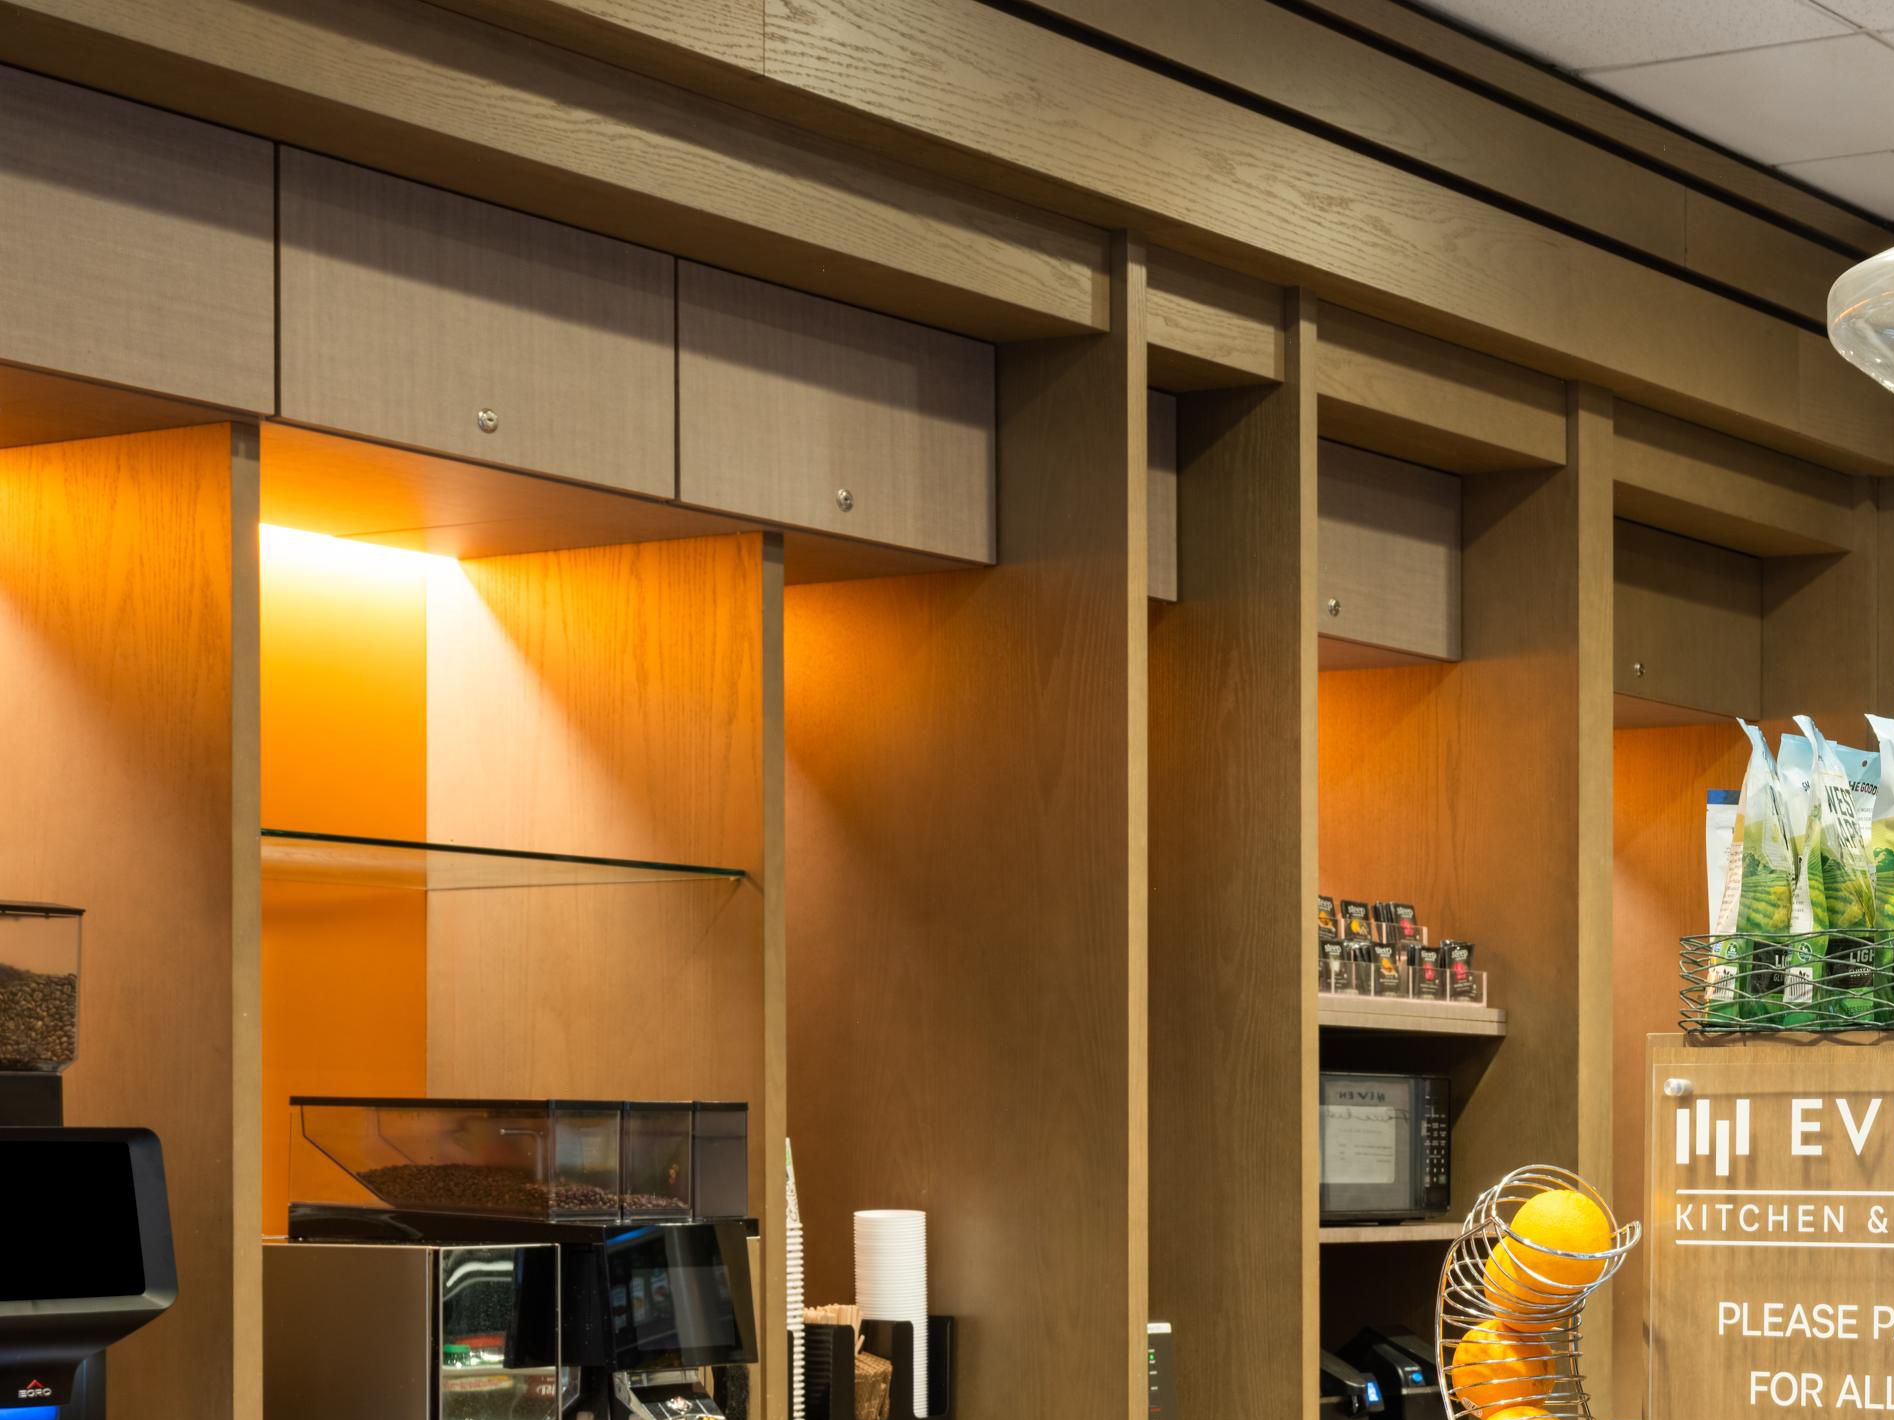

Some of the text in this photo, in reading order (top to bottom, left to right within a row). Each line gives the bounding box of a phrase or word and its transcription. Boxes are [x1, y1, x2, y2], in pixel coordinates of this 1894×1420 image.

[1675, 1203, 1845, 1233] KITCHEN
[1867, 1205, 1889, 1234] &
[1717, 1301, 1858, 1340] PLEASE
[1750, 1371, 1823, 1408] FOR
